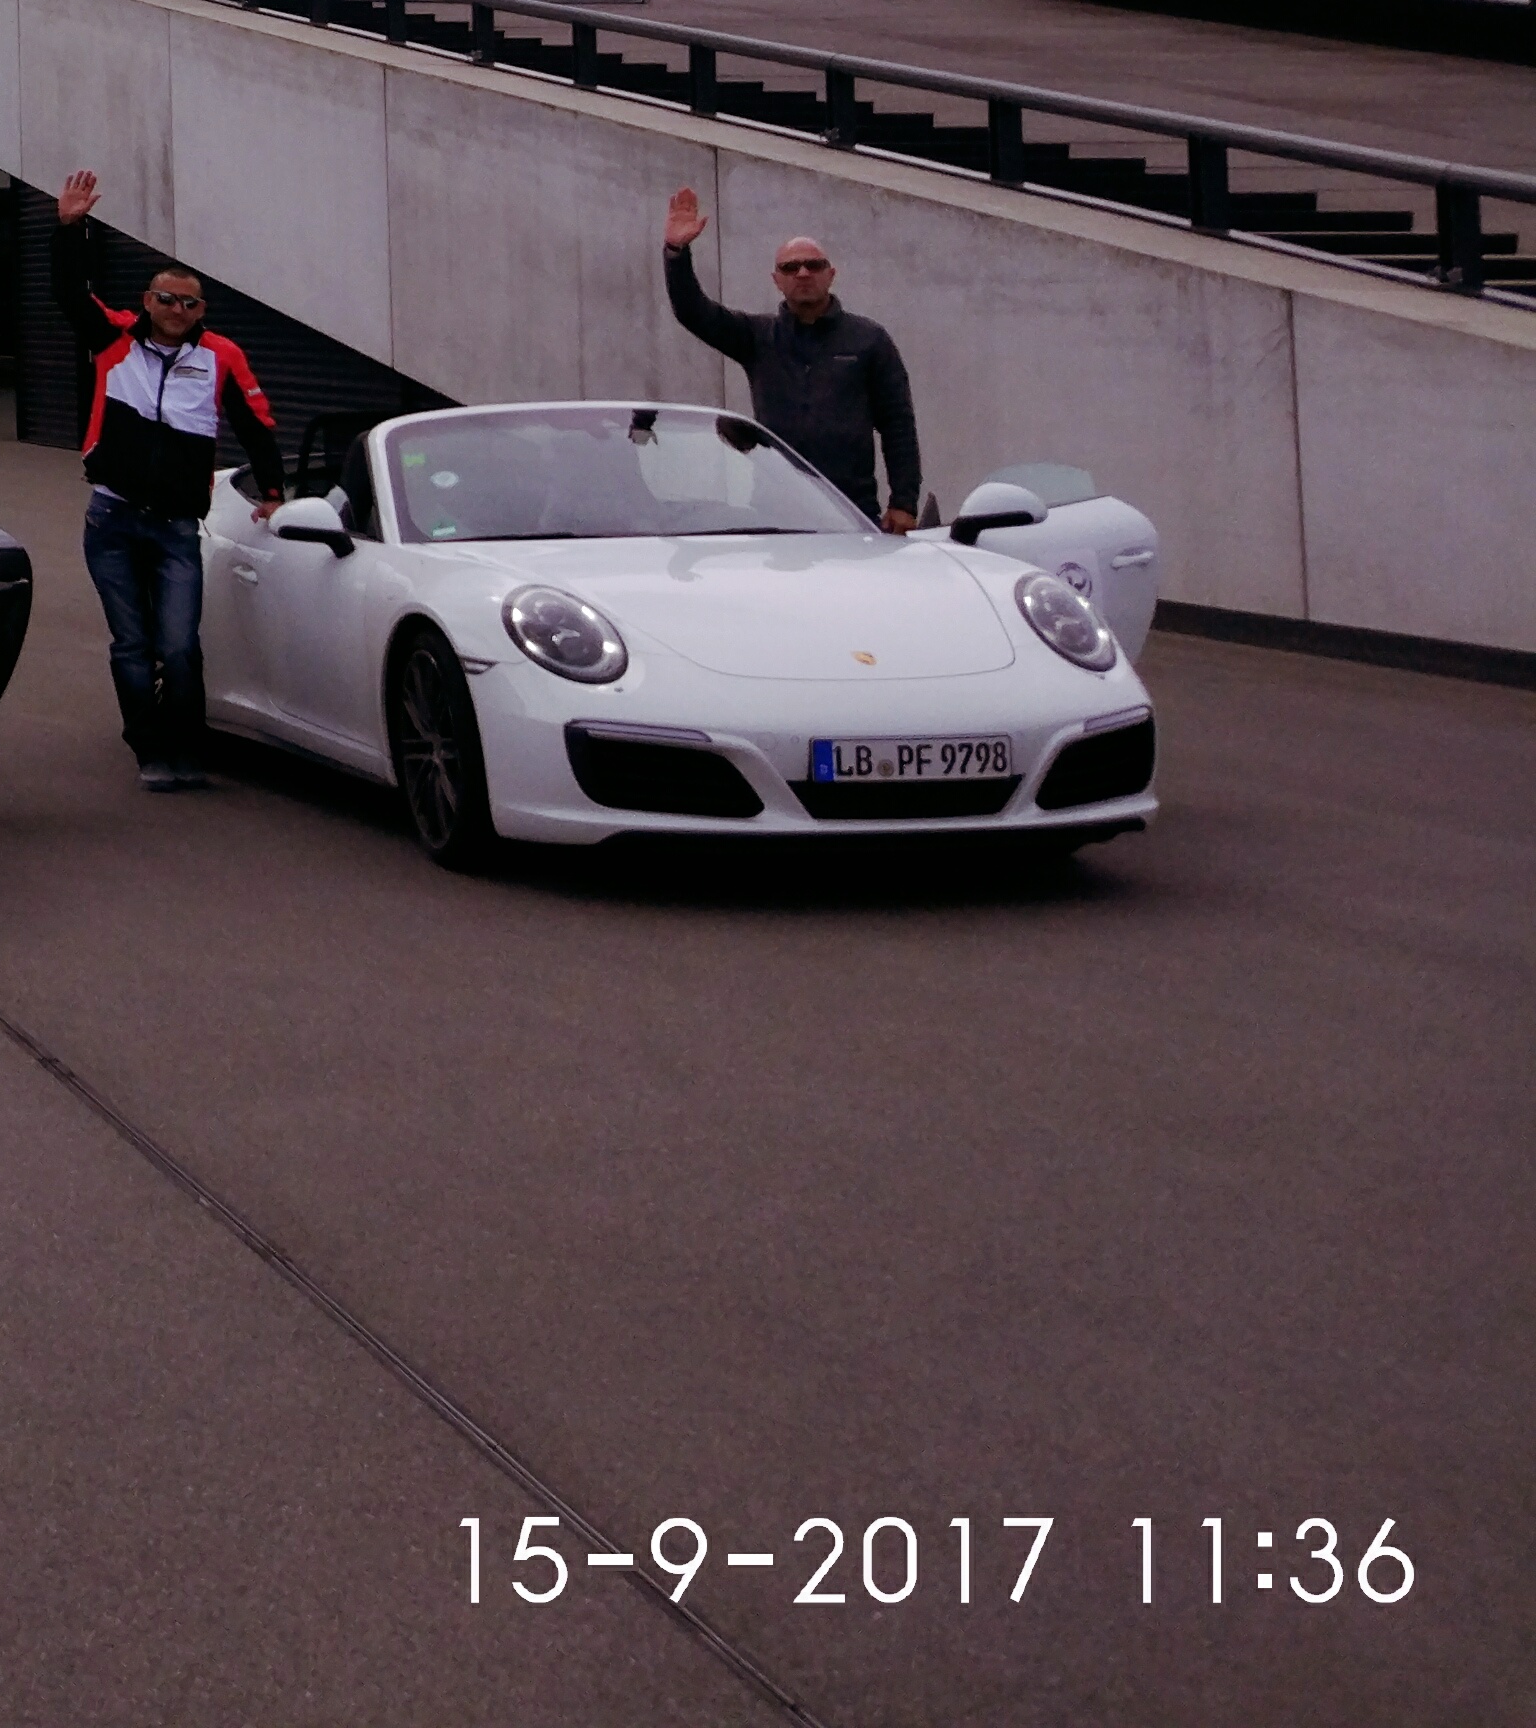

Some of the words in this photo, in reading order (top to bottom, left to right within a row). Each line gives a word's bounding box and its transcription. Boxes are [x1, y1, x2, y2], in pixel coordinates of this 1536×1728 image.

[834, 744, 873, 776] LB
[897, 744, 932, 775] PF
[940, 741, 1008, 774] 9798
